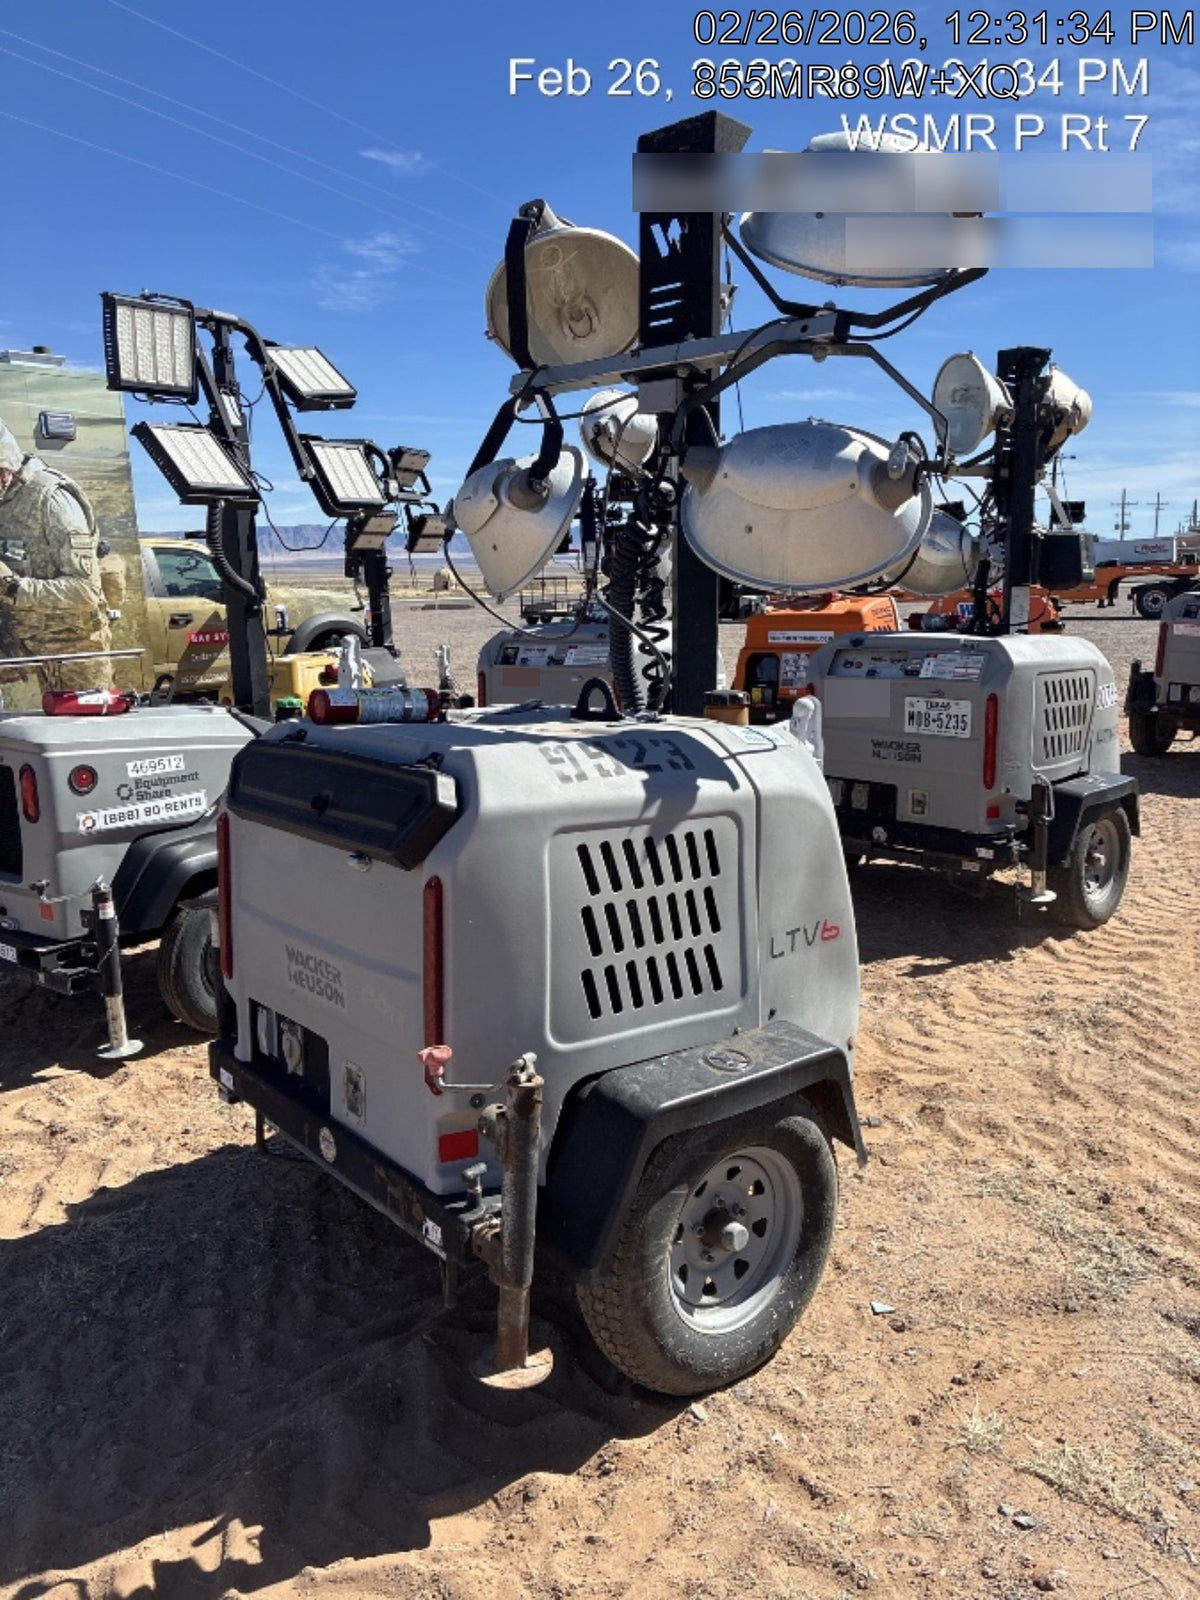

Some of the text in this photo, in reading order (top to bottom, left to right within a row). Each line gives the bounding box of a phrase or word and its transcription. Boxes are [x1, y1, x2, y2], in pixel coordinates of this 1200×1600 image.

[131, 757, 183, 775] 469512
[134, 771, 199, 790] Equipment
[135, 788, 172, 801] Share
[285, 943, 343, 988] WACKER
